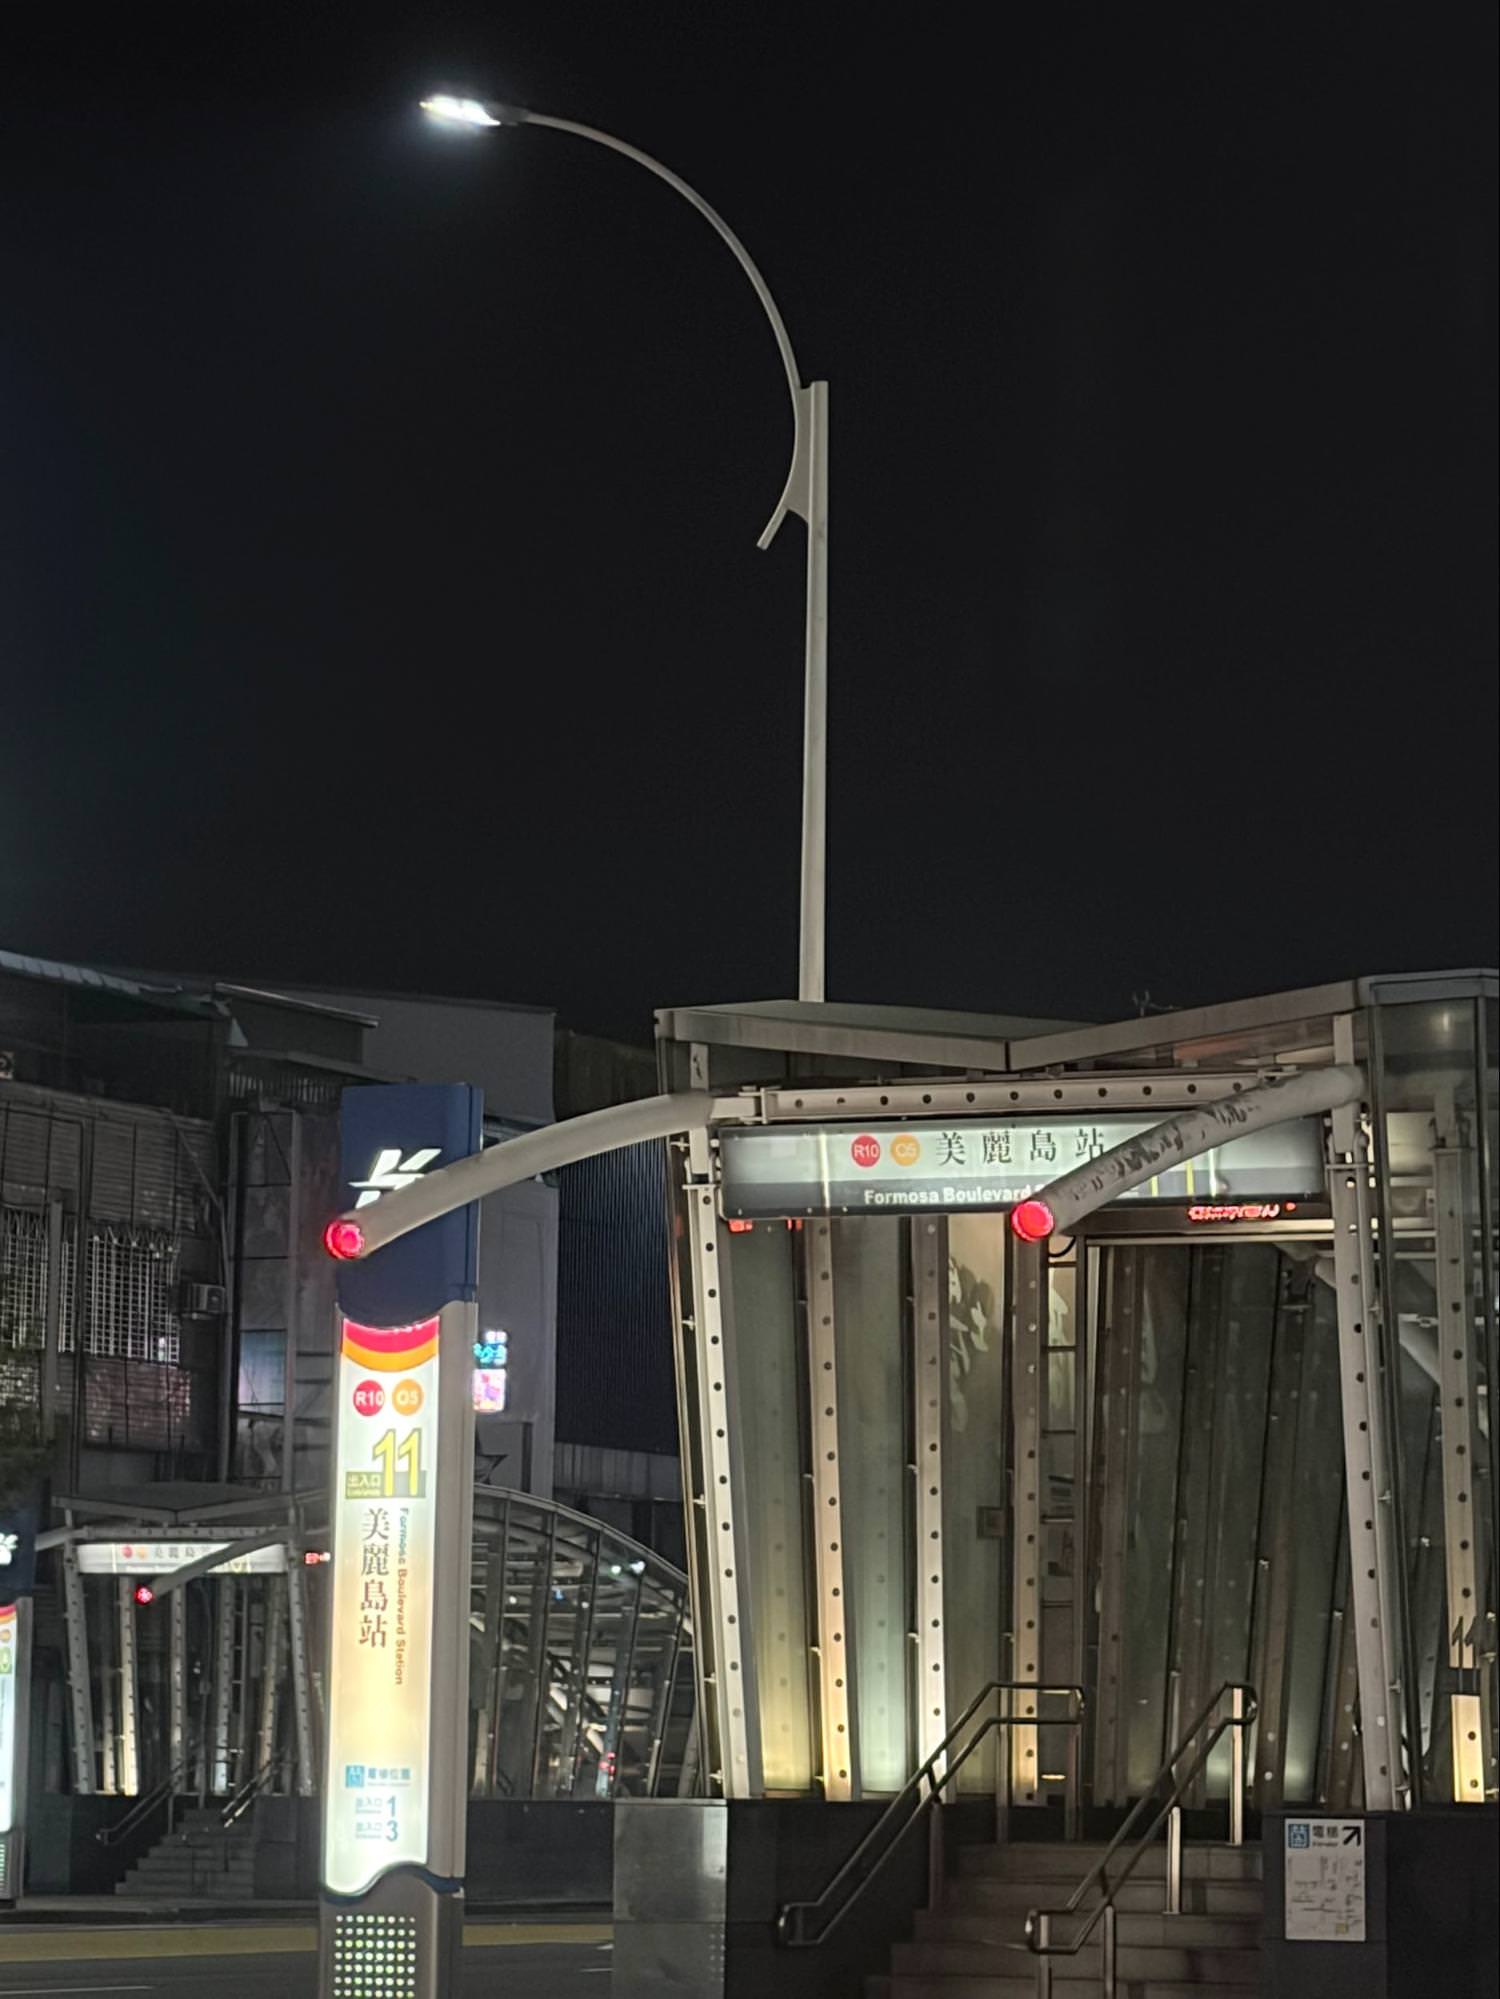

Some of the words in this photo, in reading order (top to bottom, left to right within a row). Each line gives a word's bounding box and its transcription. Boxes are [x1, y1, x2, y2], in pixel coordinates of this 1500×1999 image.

[854, 1143, 880, 1158] R10
[936, 1127, 1105, 1166] 美麗島站
[864, 1188, 940, 1205] Formosa
[943, 1184, 1031, 1203] Boulevard
[355, 1390, 385, 1407] R10
[371, 1427, 423, 1498] 11
[359, 1506, 390, 1649] 美麗島站
[397, 1568, 408, 1636] Boulevard
[395, 1639, 407, 1686] Station
[385, 1819, 398, 1842] 3
